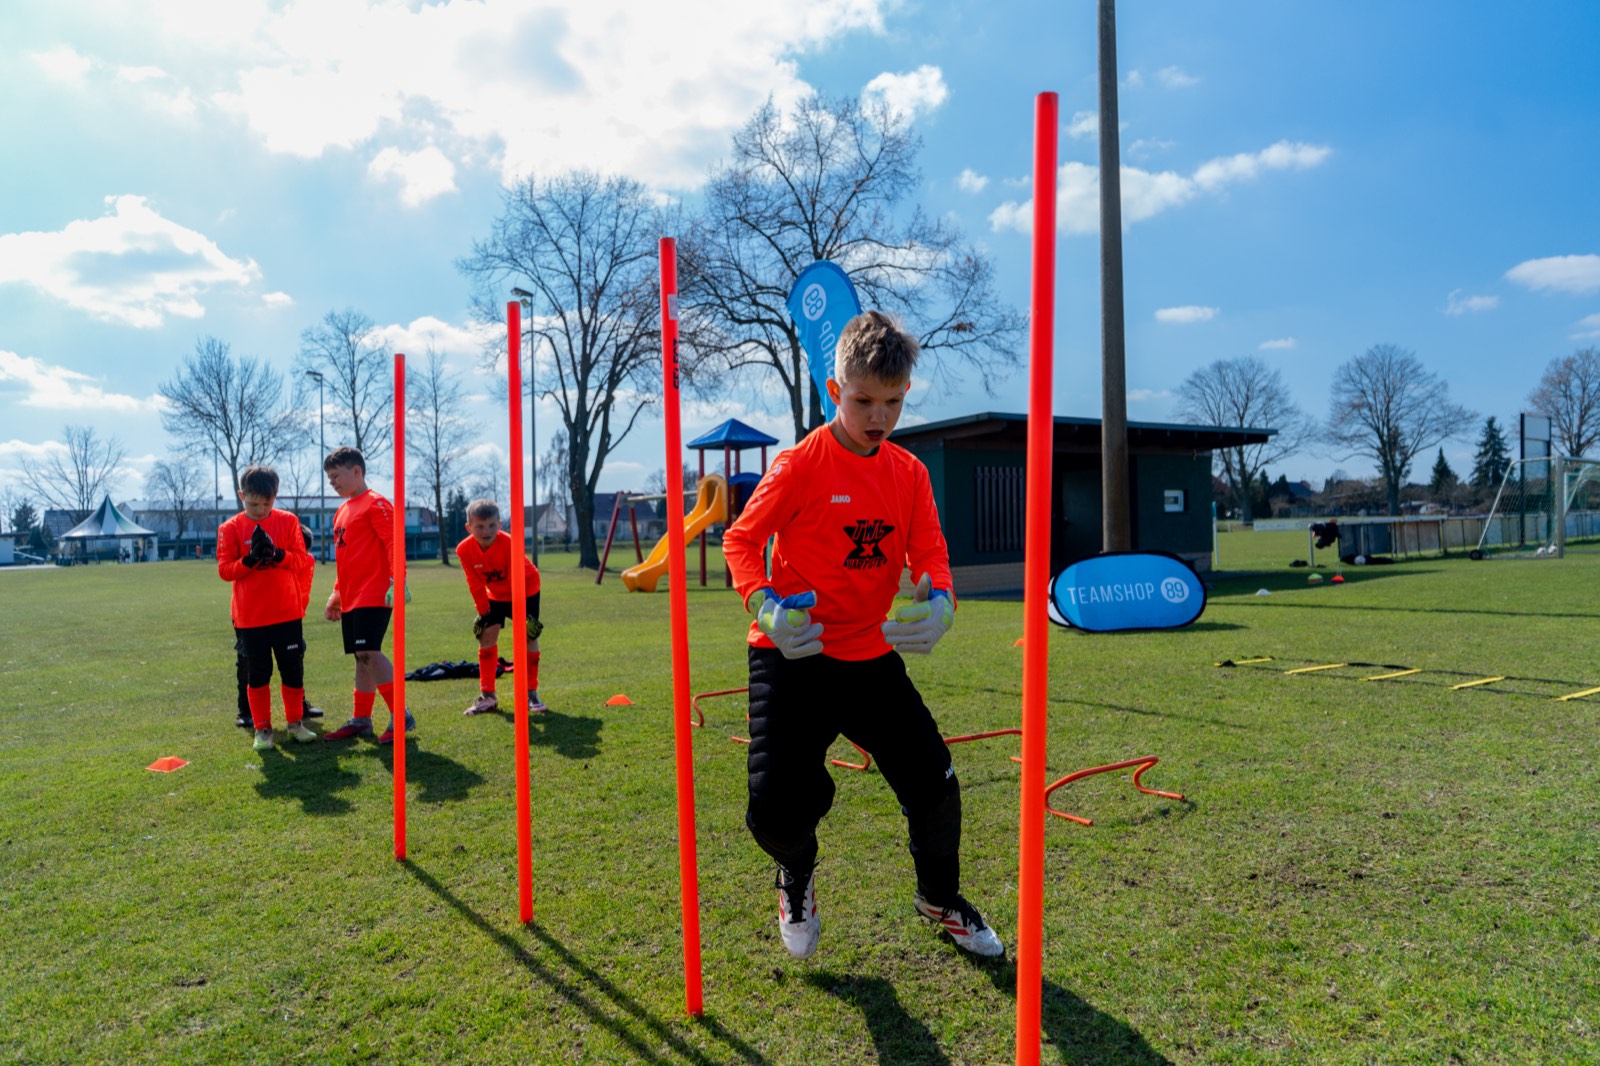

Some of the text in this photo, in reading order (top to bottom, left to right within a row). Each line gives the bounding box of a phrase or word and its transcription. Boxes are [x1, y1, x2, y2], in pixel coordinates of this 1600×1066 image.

[830, 494, 851, 504] JAKO
[1067, 581, 1185, 605] TEAMSHOP 89
